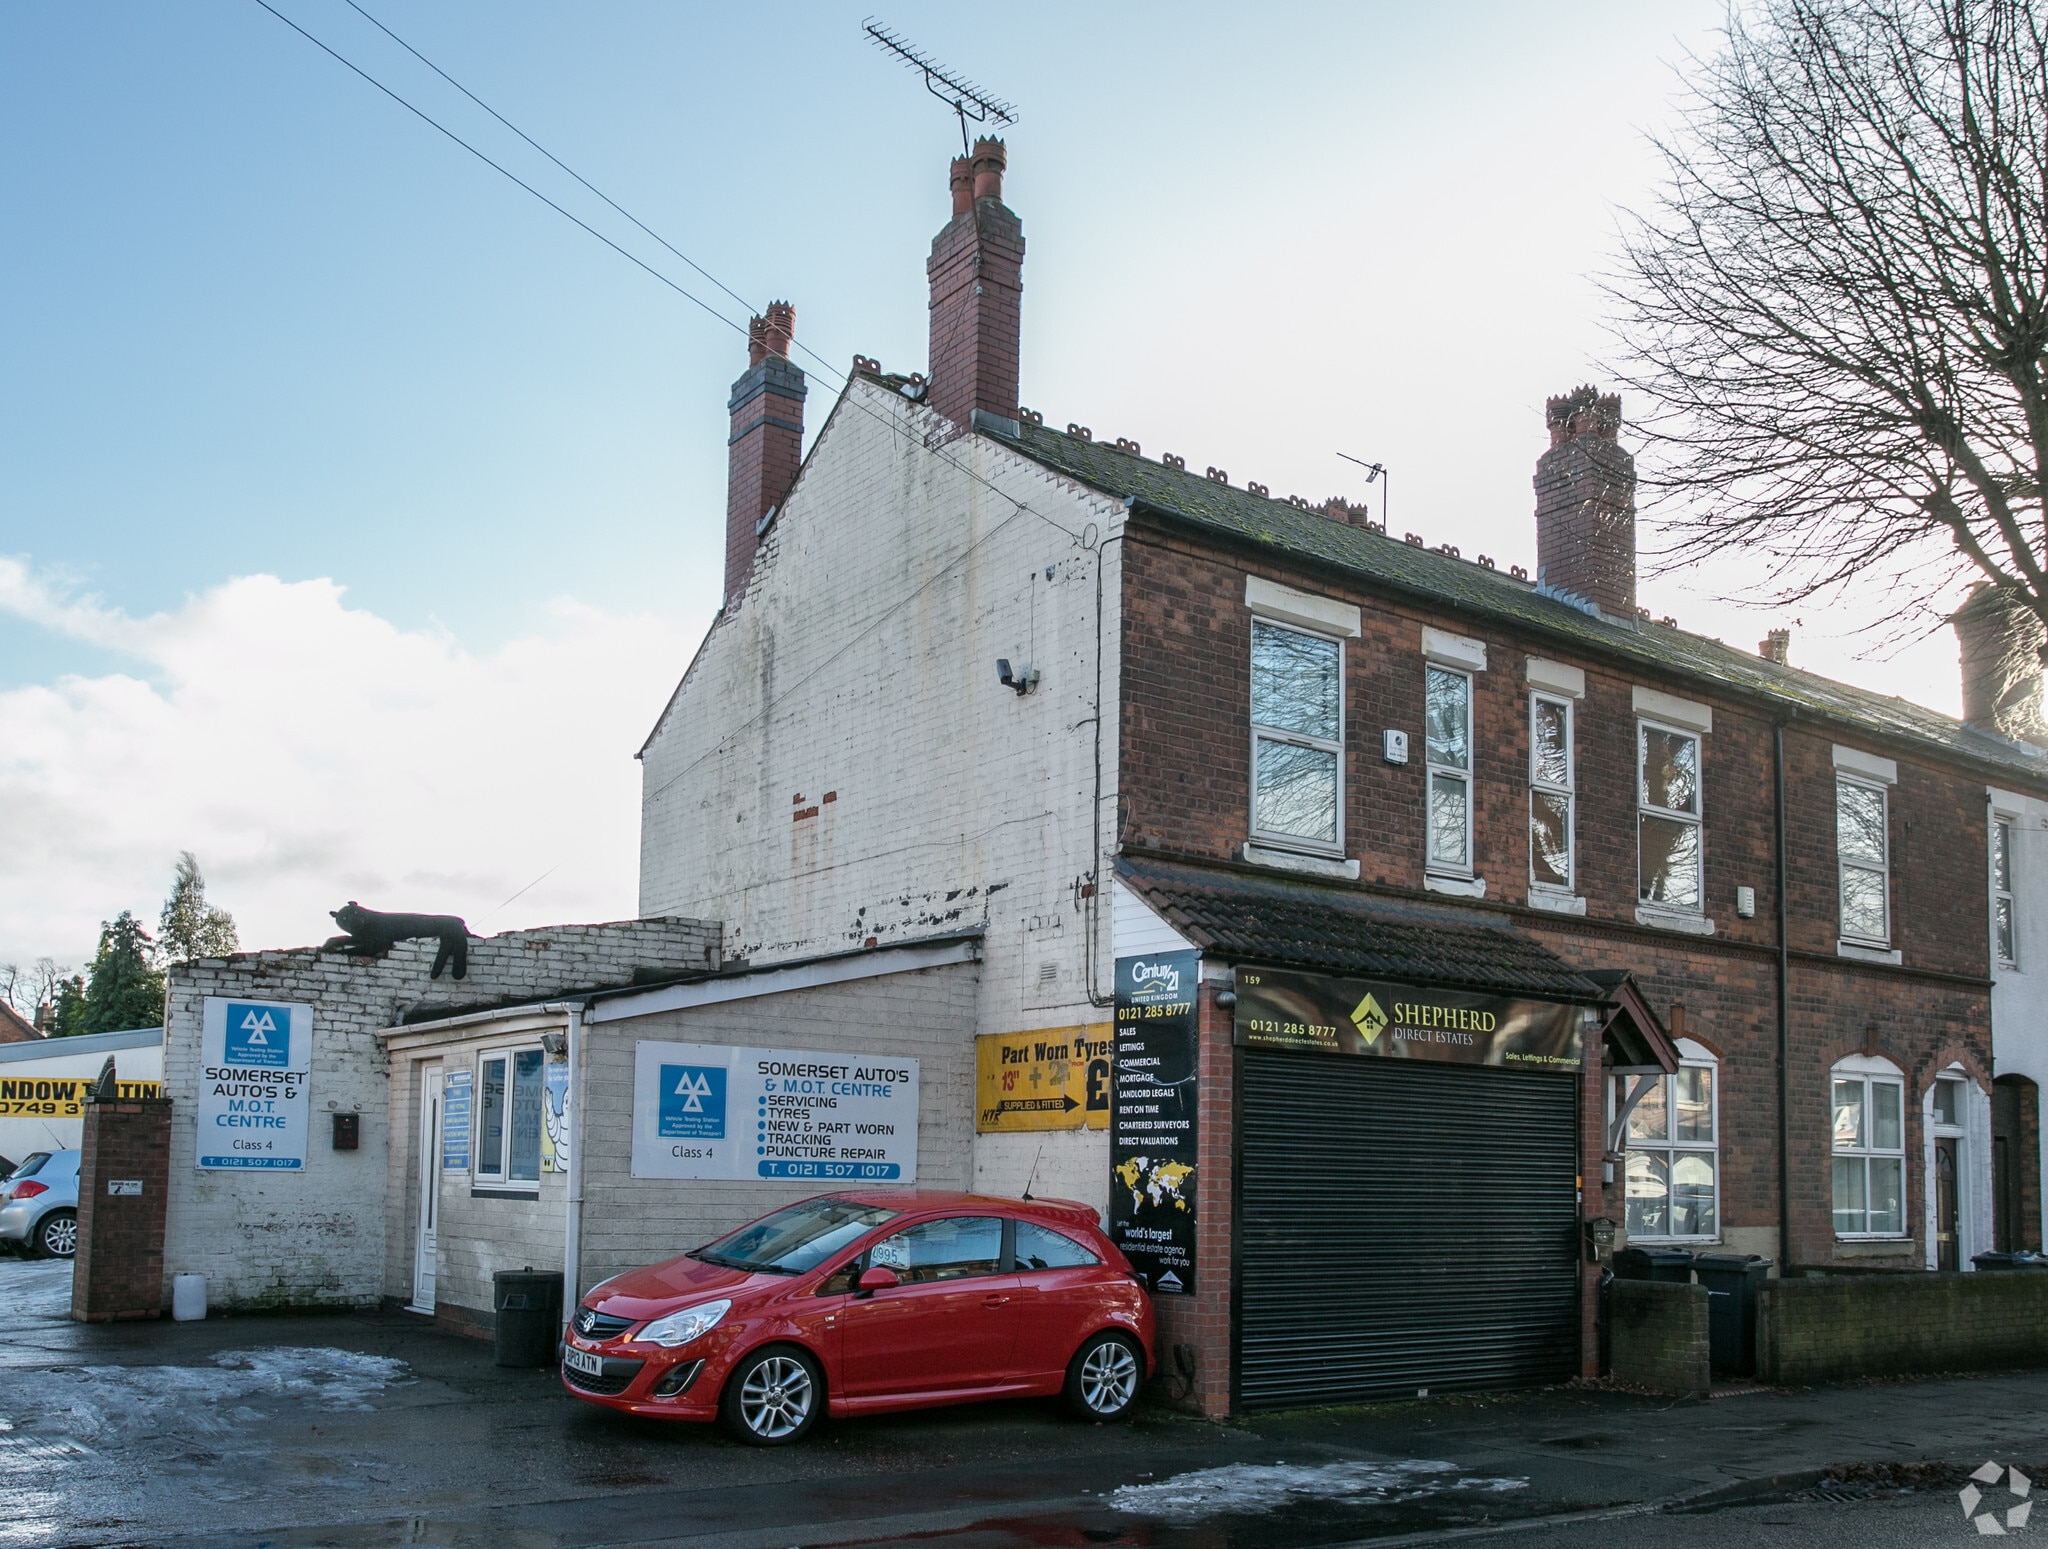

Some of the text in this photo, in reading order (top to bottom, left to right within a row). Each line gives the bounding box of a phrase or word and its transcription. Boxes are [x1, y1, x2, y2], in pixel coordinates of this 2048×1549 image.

[1132, 961, 1172, 983] Century
[1166, 970, 1179, 991] 21
[1244, 975, 1261, 985] 159
[1131, 993, 1178, 1004] UNITED KINGDOM
[1118, 1001, 1191, 1020] 0121 285 8777
[1394, 1002, 1496, 1032] SHEPHERD
[1119, 1027, 1136, 1036] SALES
[1250, 1019, 1336, 1037] 0121 285 8777
[1394, 1027, 1474, 1046] DIRECT ESTATES
[1001, 1038, 1113, 1064] Part Worn Tyres
[1119, 1042, 1145, 1052] LETTINGS
[1119, 1057, 1161, 1067] COMMERCIAL
[1522, 1053, 1543, 1063] Lettings
[1548, 1055, 1581, 1066] Commercial
[205, 1067, 307, 1084] SOMERSET
[758, 1061, 909, 1083] SOMERSET AUTO'S
[1119, 1073, 1154, 1083] MORTGAGE
[213, 1083, 298, 1099] AUTO'S &
[765, 1078, 892, 1098] & M.O.T. CENTRE
[1119, 1088, 1175, 1098] LANDLORD LEGALS
[229, 1099, 275, 1113] M.O.T.
[768, 1095, 837, 1108] SERVICING
[1004, 1100, 1035, 1111] SUPPLIED
[1041, 1098, 1065, 1109] FITTED
[768, 1107, 810, 1120] TYRES
[1119, 1104, 1160, 1114] RENT ON TIME
[216, 1114, 286, 1129] CENTRE
[768, 1120, 895, 1135] NEW & PART WORN
[1118, 1120, 1190, 1130] CHARTERED SURVEYORS
[232, 1139, 273, 1150] Class 4
[767, 1133, 831, 1146] TRACKING
[1118, 1136, 1179, 1145] DIRECT VALUATIONS
[671, 1145, 713, 1159] Class 4
[766, 1145, 886, 1160] PUNCTURE REPAIR
[221, 1158, 243, 1166] 0121
[273, 1159, 294, 1167] 1017
[769, 1163, 890, 1177] T. 0121 507 1017
[1125, 1227, 1172, 1242] world's largest
[1120, 1242, 1186, 1257] residential estate agency
[1159, 1256, 1190, 1267] work for you
[581, 1354, 597, 1372] ATN
